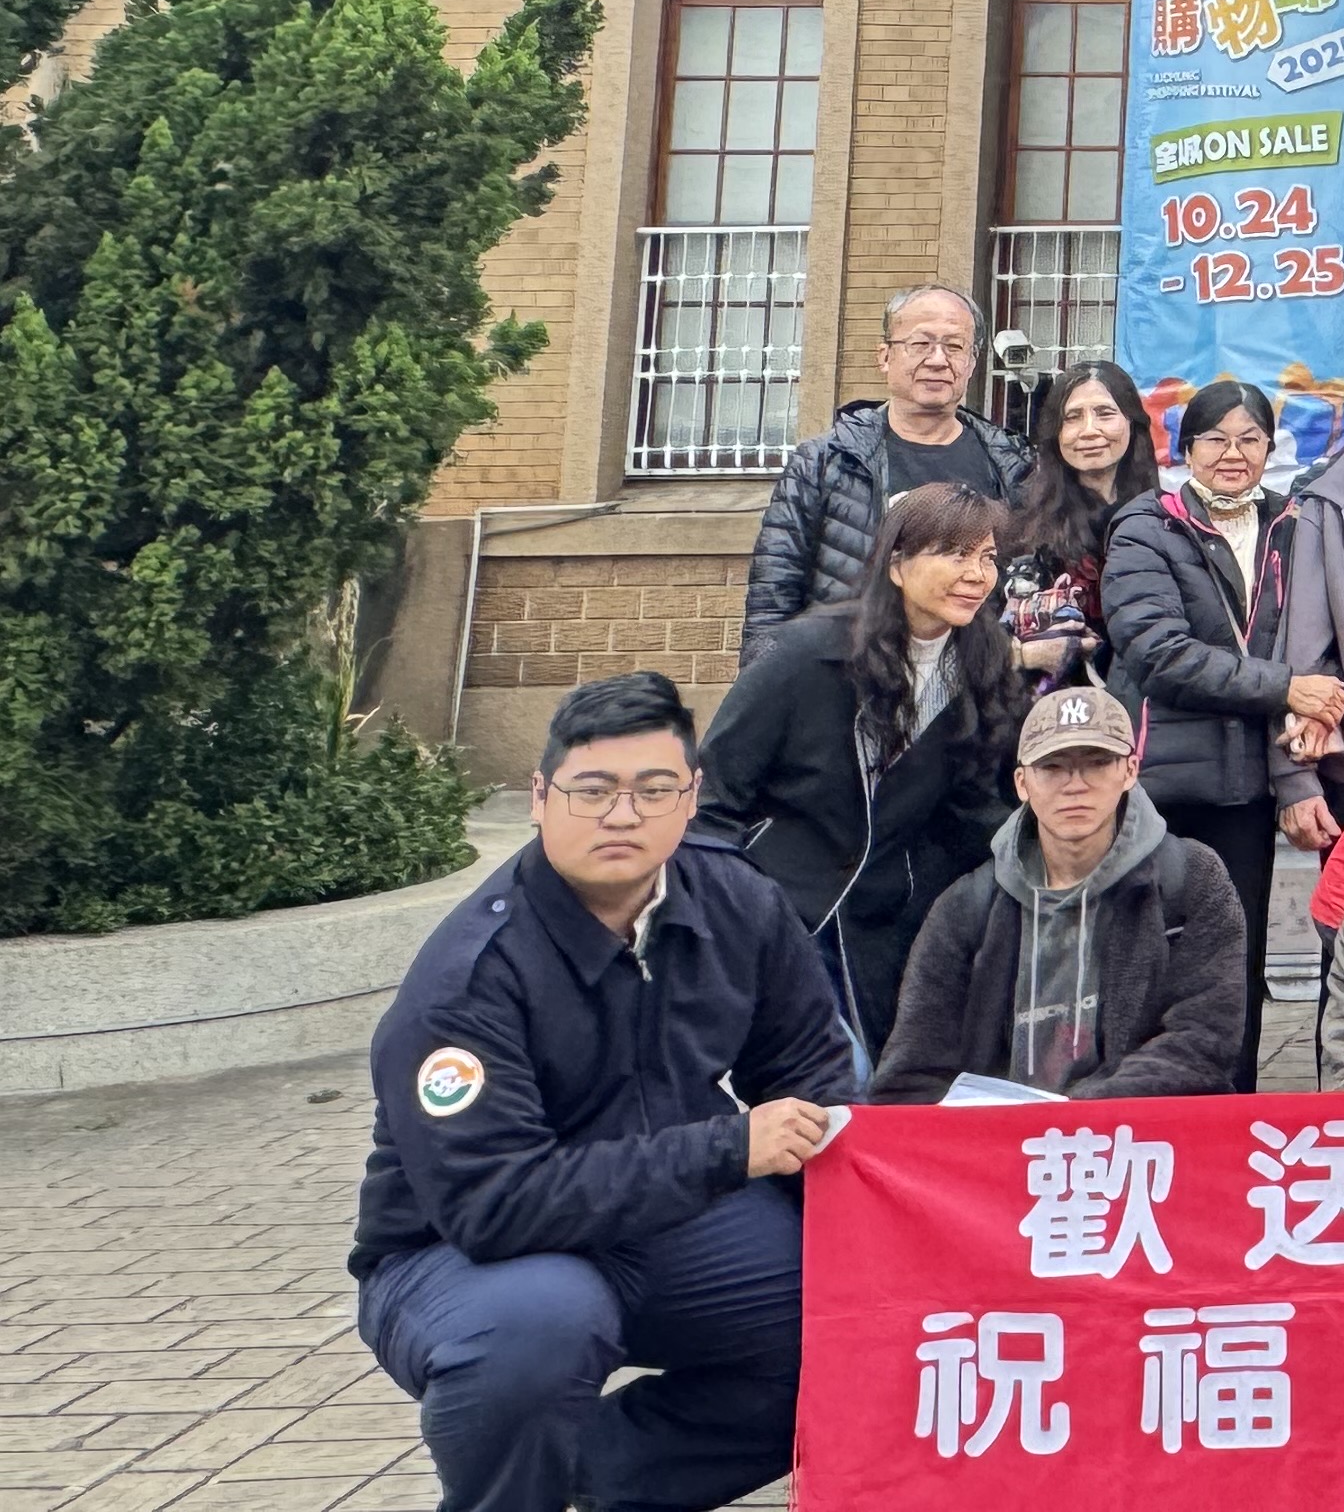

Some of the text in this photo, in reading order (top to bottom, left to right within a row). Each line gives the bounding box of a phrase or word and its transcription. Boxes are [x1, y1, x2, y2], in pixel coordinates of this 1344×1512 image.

[1260, 123, 1329, 164] SALE
[1162, 185, 1317, 246] 10.24
[1060, 698, 1090, 725] NY
